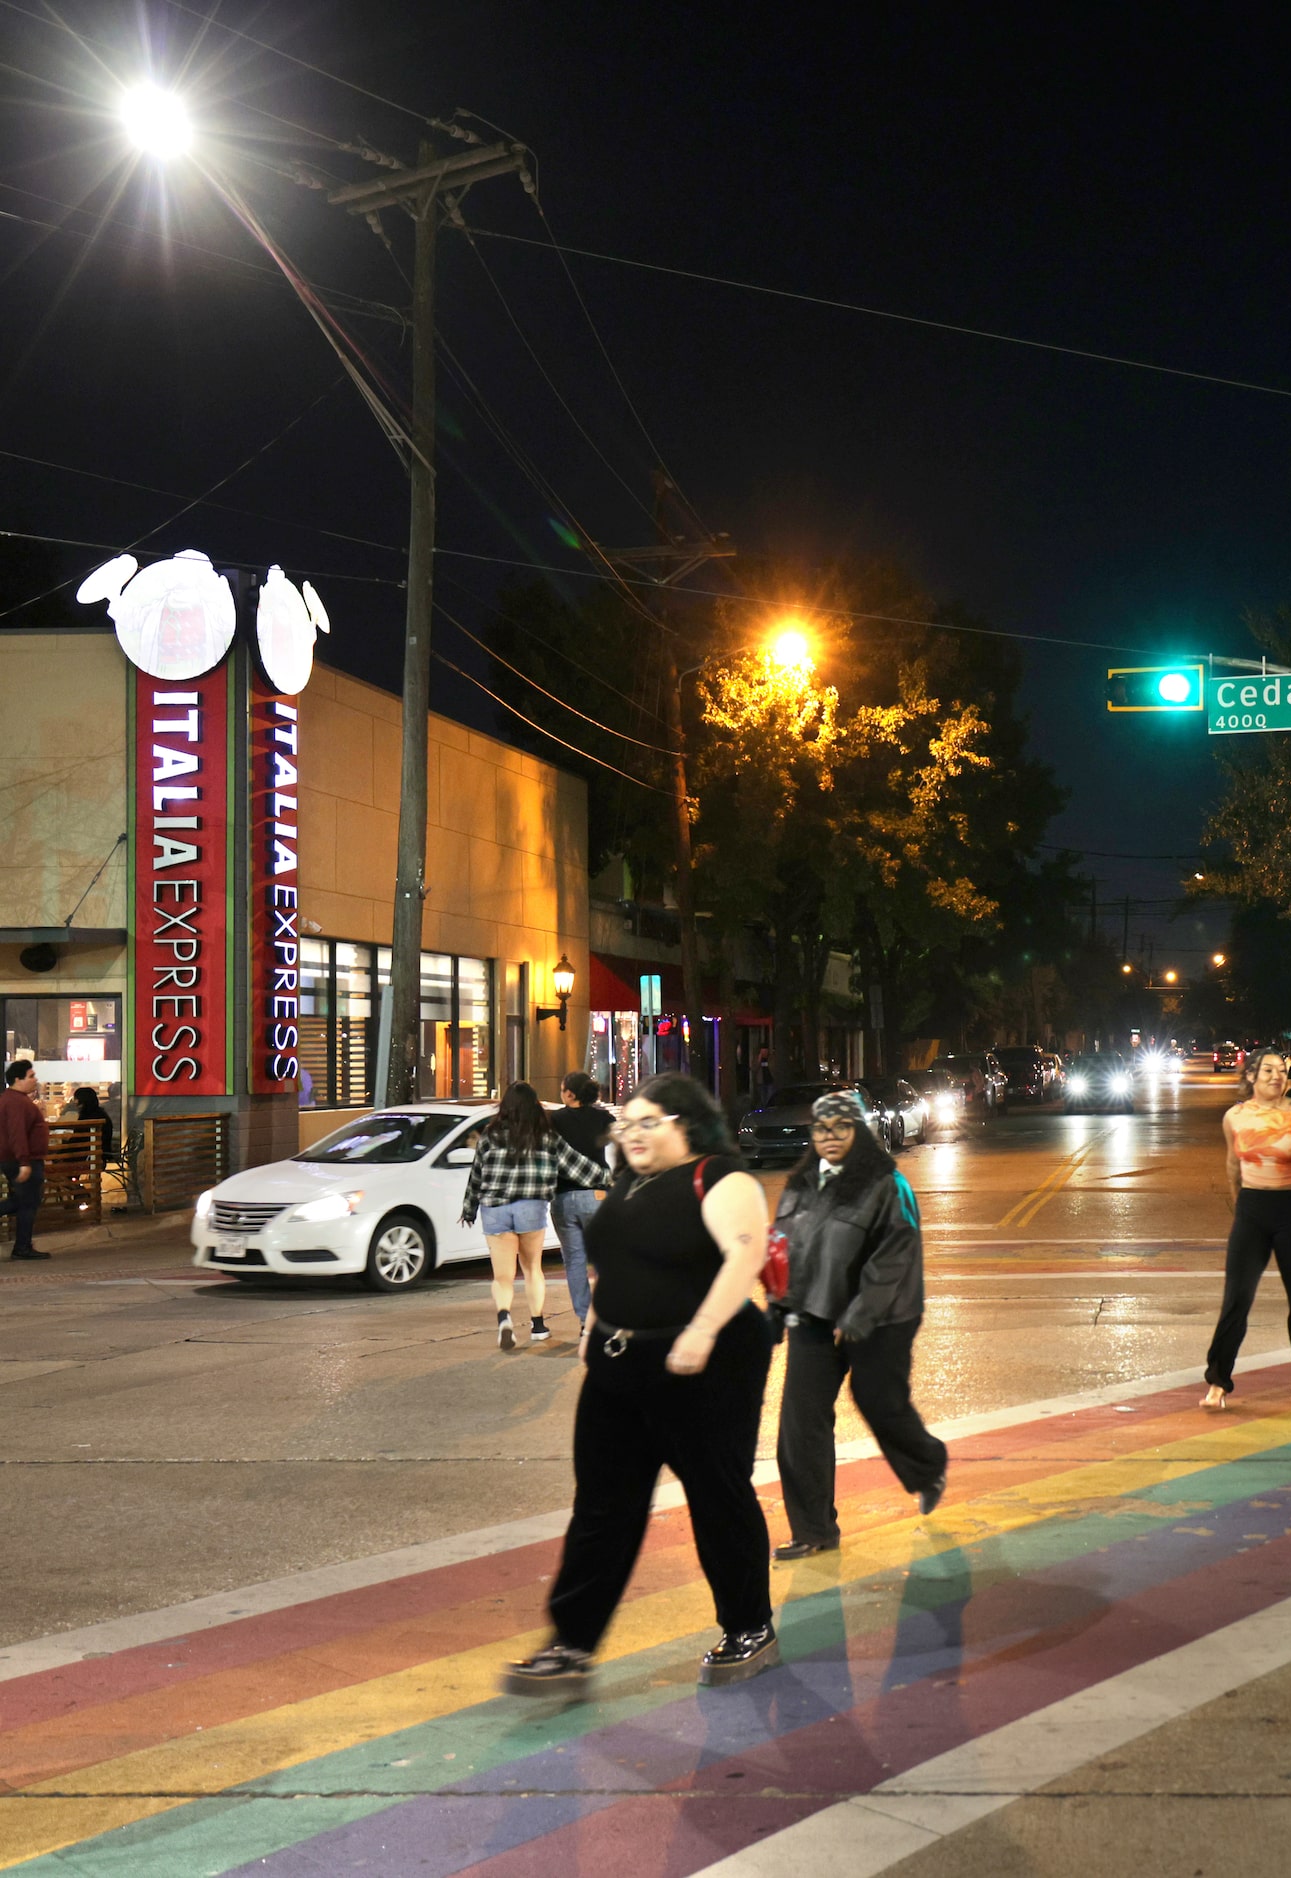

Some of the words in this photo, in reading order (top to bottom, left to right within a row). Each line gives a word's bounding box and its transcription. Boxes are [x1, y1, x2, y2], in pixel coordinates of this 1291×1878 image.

[152, 691, 199, 870] ITALIA
[274, 701, 298, 875] ITALIA
[1215, 713, 1267, 729] 4000
[151, 879, 198, 1082] EXPRESS
[273, 883, 299, 1082] EXPRESS
